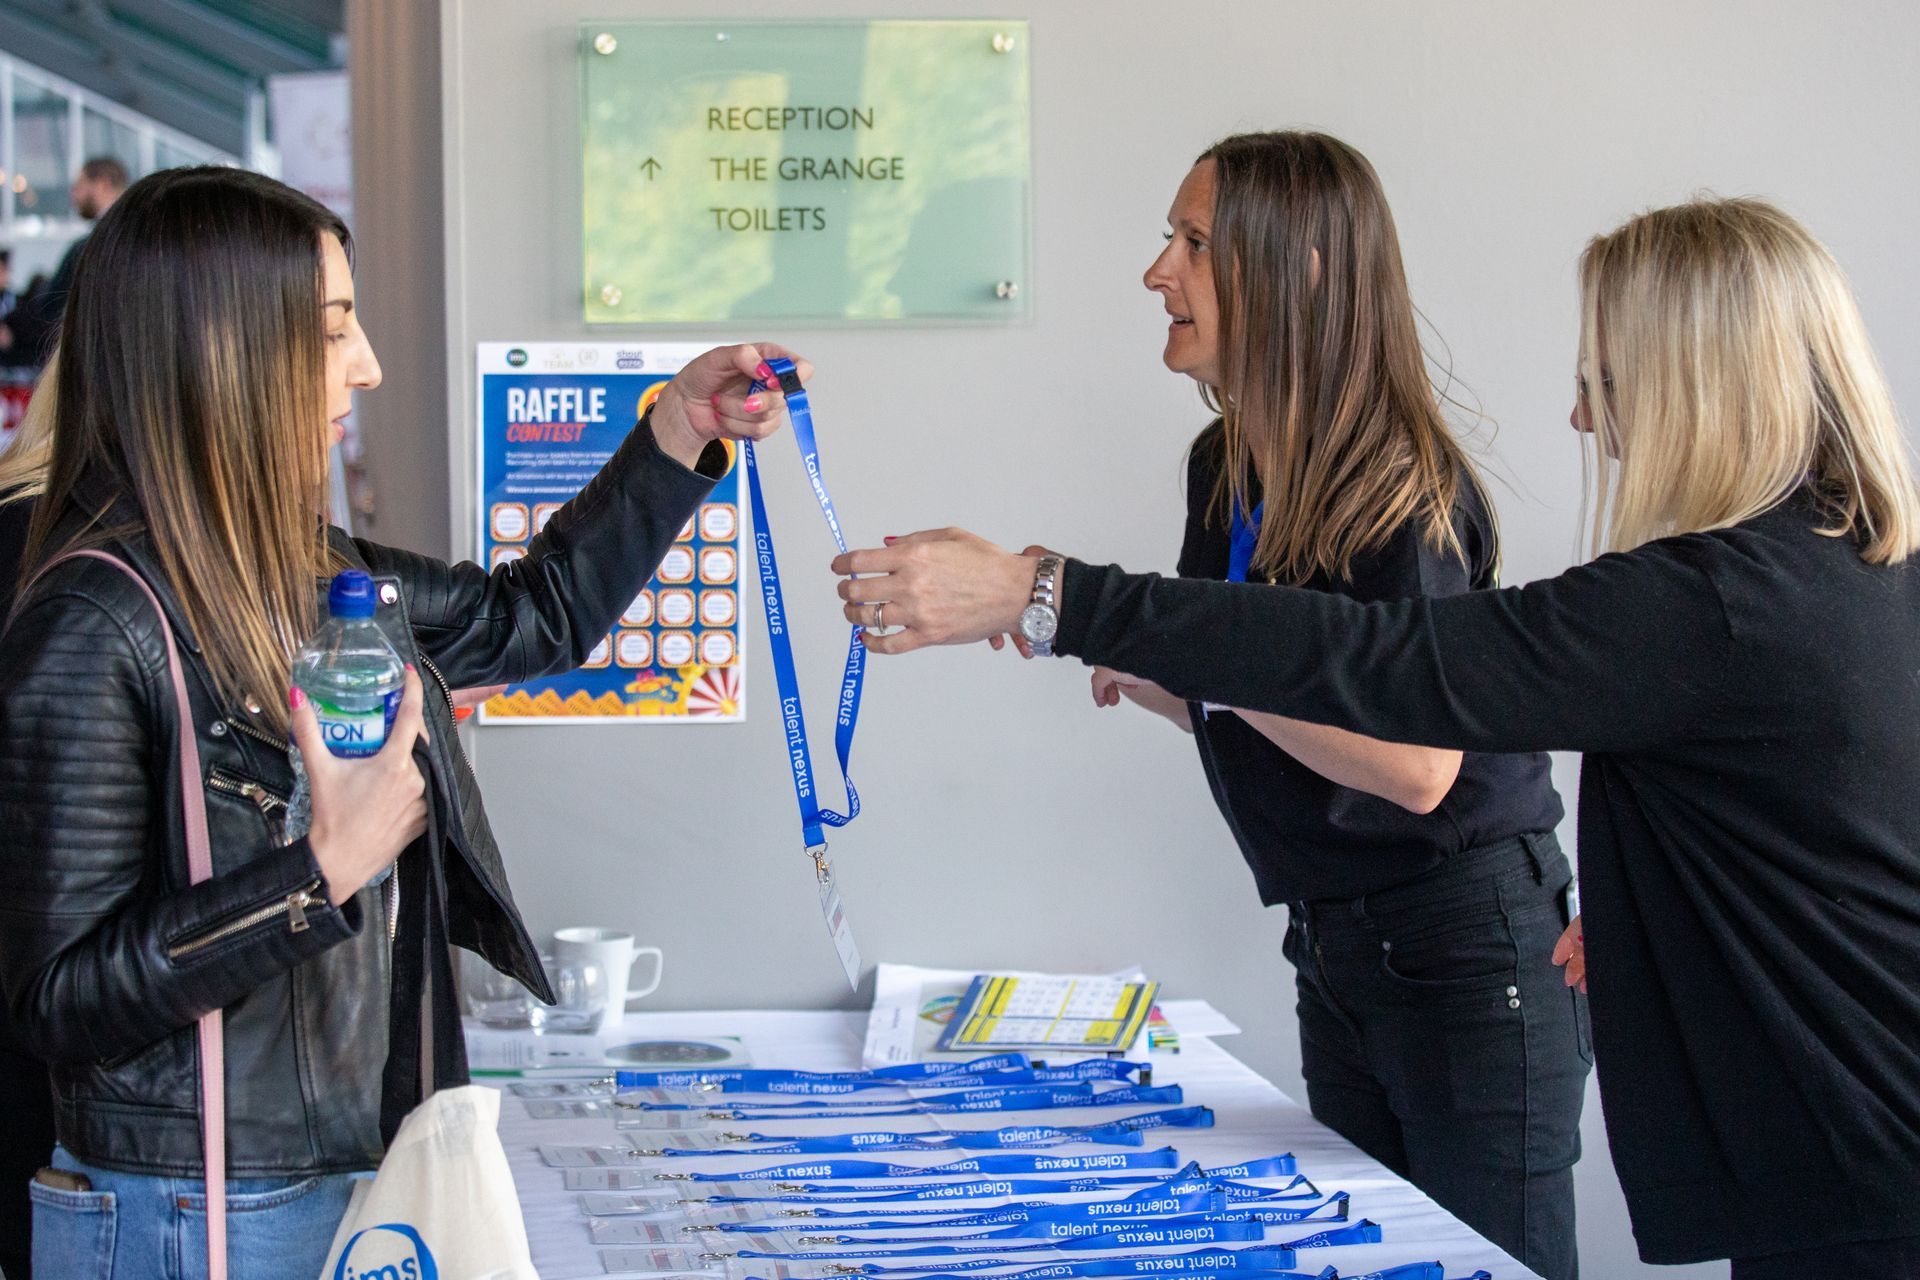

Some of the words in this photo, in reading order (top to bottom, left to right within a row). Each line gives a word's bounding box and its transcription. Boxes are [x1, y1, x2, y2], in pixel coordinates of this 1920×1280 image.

[708, 107, 875, 131] RECEPTION
[710, 157, 768, 181] THE
[778, 157, 904, 181] GRANGE
[710, 208, 826, 231] TOILETS
[507, 387, 607, 423] RAFFLE
[506, 422, 587, 442] CONTEST
[805, 452, 830, 508] talent
[825, 508, 847, 553] nexu
[757, 532, 777, 582] talent
[764, 585, 783, 635] nexus
[839, 678, 857, 726] nexus
[783, 696, 804, 747] talent
[318, 720, 364, 742] TON
[792, 748, 811, 798] nexus
[768, 1082, 811, 1093] talent
[812, 1083, 855, 1093] nexus
[959, 1099, 1002, 1110] nexus
[851, 1133, 895, 1146] nexus
[998, 1129, 1042, 1144] talent
[1034, 1158, 1080, 1170] nexus
[1081, 1154, 1128, 1170] talent
[738, 1167, 785, 1180] talent
[786, 1165, 832, 1178] nexus
[1202, 1166, 1249, 1178] talent
[916, 1189, 964, 1199] nexus
[965, 1181, 1014, 1198] talent
[1087, 1203, 1133, 1215] nexus
[1136, 1199, 1181, 1215] talent
[1254, 1211, 1300, 1222] nexus
[1050, 1222, 1097, 1237] talent
[1117, 1230, 1165, 1243] nexus
[1167, 1227, 1215, 1244] talent
[1135, 1258, 1185, 1272] nexus
[1187, 1254, 1237, 1271] talent
[1022, 1265, 1074, 1279] talent
